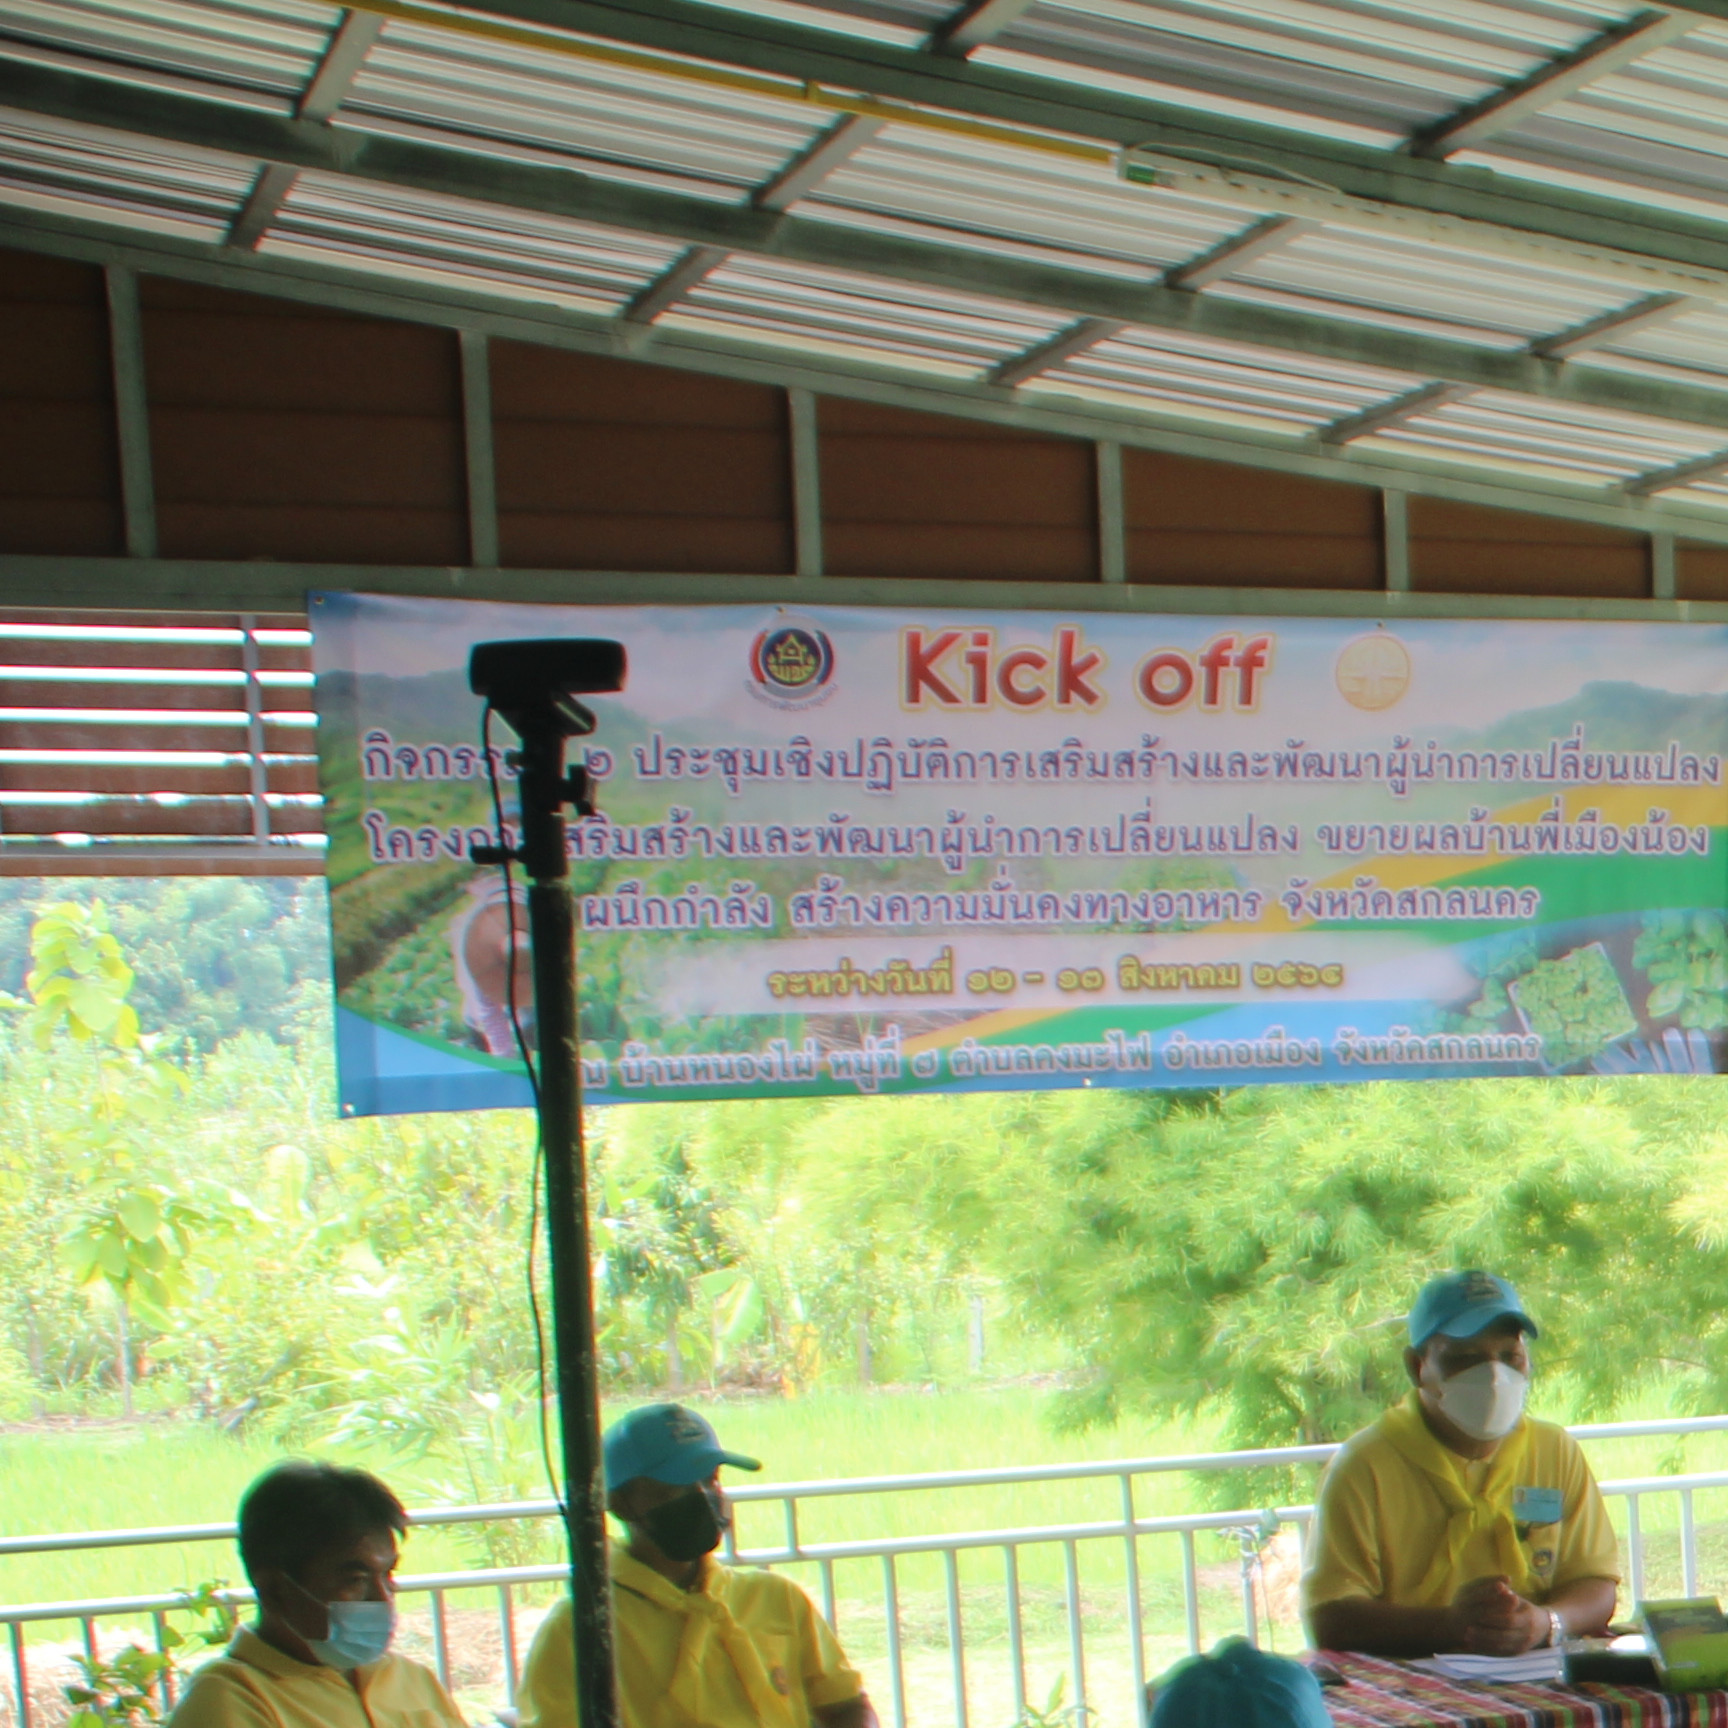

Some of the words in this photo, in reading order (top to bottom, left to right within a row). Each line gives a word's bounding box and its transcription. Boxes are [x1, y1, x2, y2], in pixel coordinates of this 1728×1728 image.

[903, 629, 1102, 708] Kick
[1137, 634, 1272, 708] off
[1316, 797, 1708, 853] ขยายผลบ้านพี่เมืองน้อง
[583, 880, 770, 926] ผนึกกำลัง
[792, 864, 1261, 925] สร้างความมั่นคงทางอาหาร
[1281, 876, 1539, 919] จังหวัดสกลนคร
[768, 946, 953, 996] ระหว่างวันที่
[1117, 953, 1240, 990] สิงหาคม
[1163, 1026, 1322, 1069] อำเภอเมือง
[1335, 1027, 1542, 1066] จังหวัดสกลนคร
